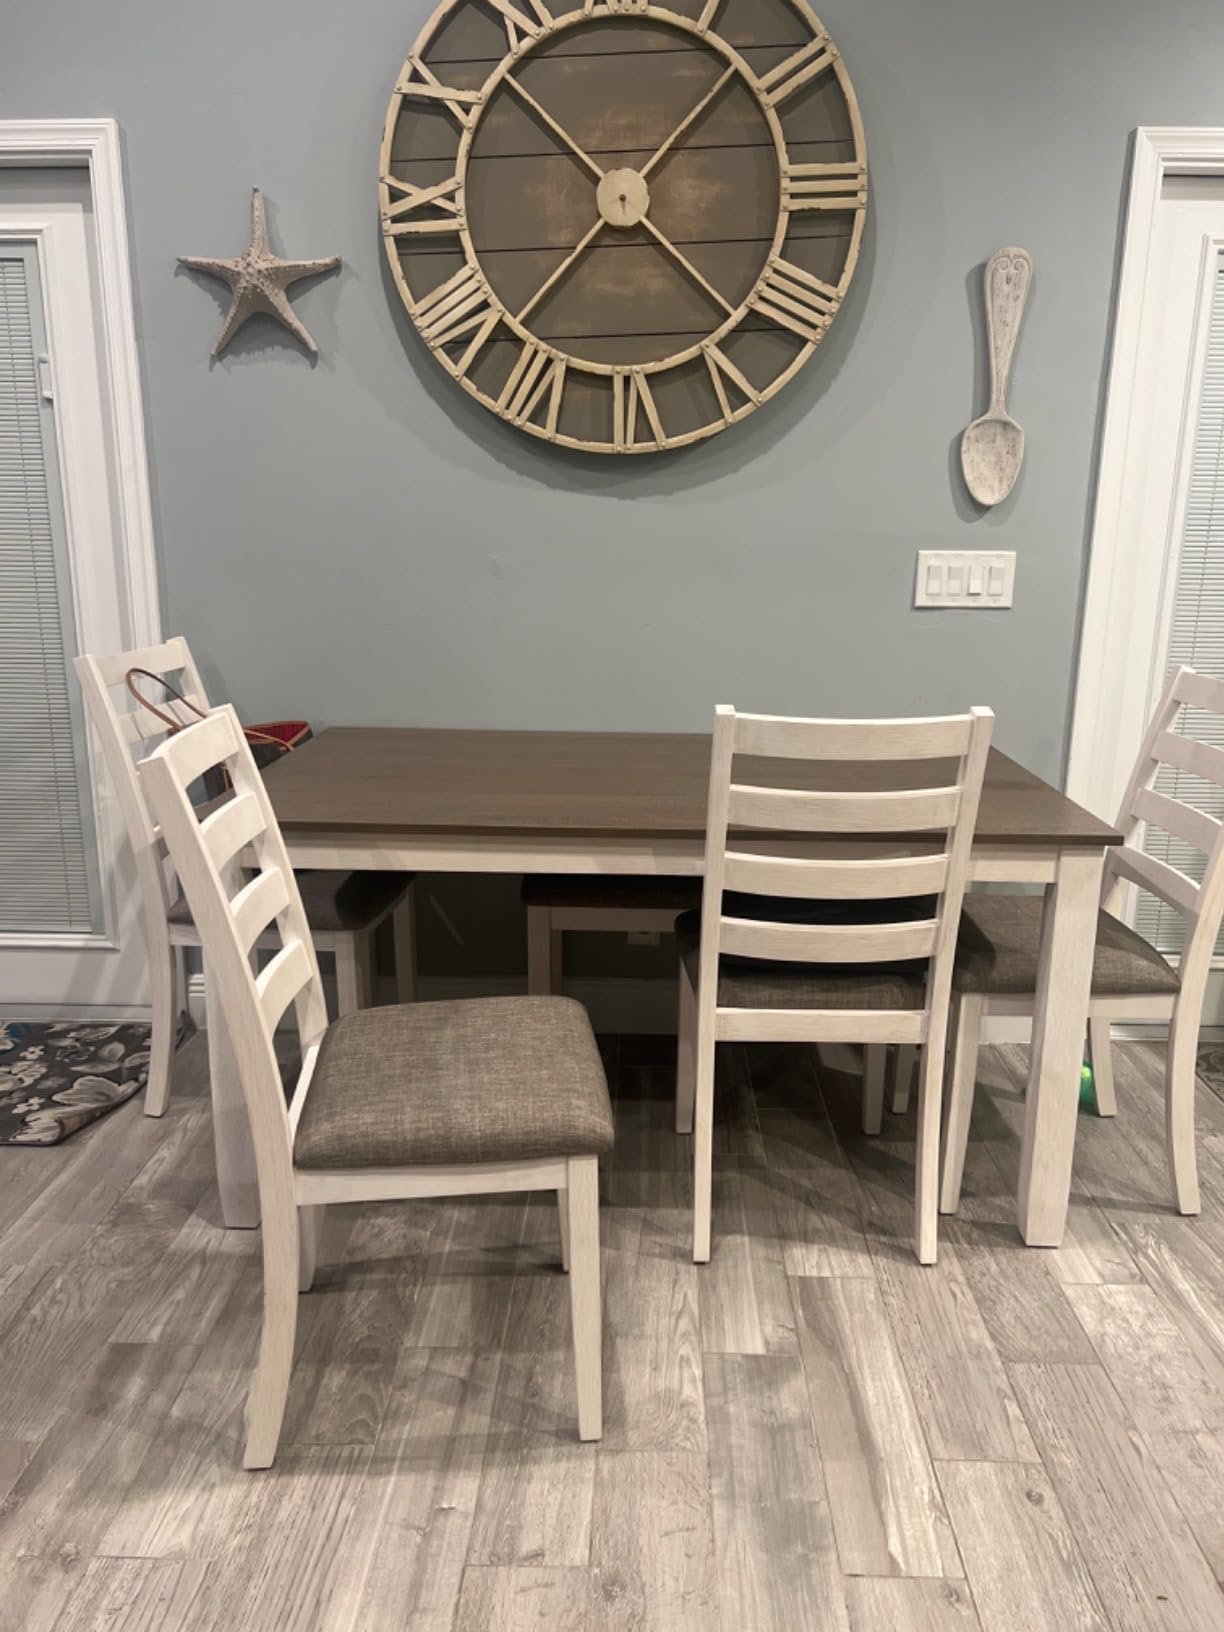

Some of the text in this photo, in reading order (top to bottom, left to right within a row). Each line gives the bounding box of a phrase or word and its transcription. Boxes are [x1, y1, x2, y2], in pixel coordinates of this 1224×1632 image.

[394, 53, 484, 132] X
[754, 33, 839, 110] II
[379, 175, 467, 236] IX
[780, 163, 867, 211] III
[410, 262, 505, 381] VIII
[747, 254, 843, 343] IIII
[495, 337, 567, 441] VII
[612, 365, 668, 453] VI
[701, 341, 762, 425] V
